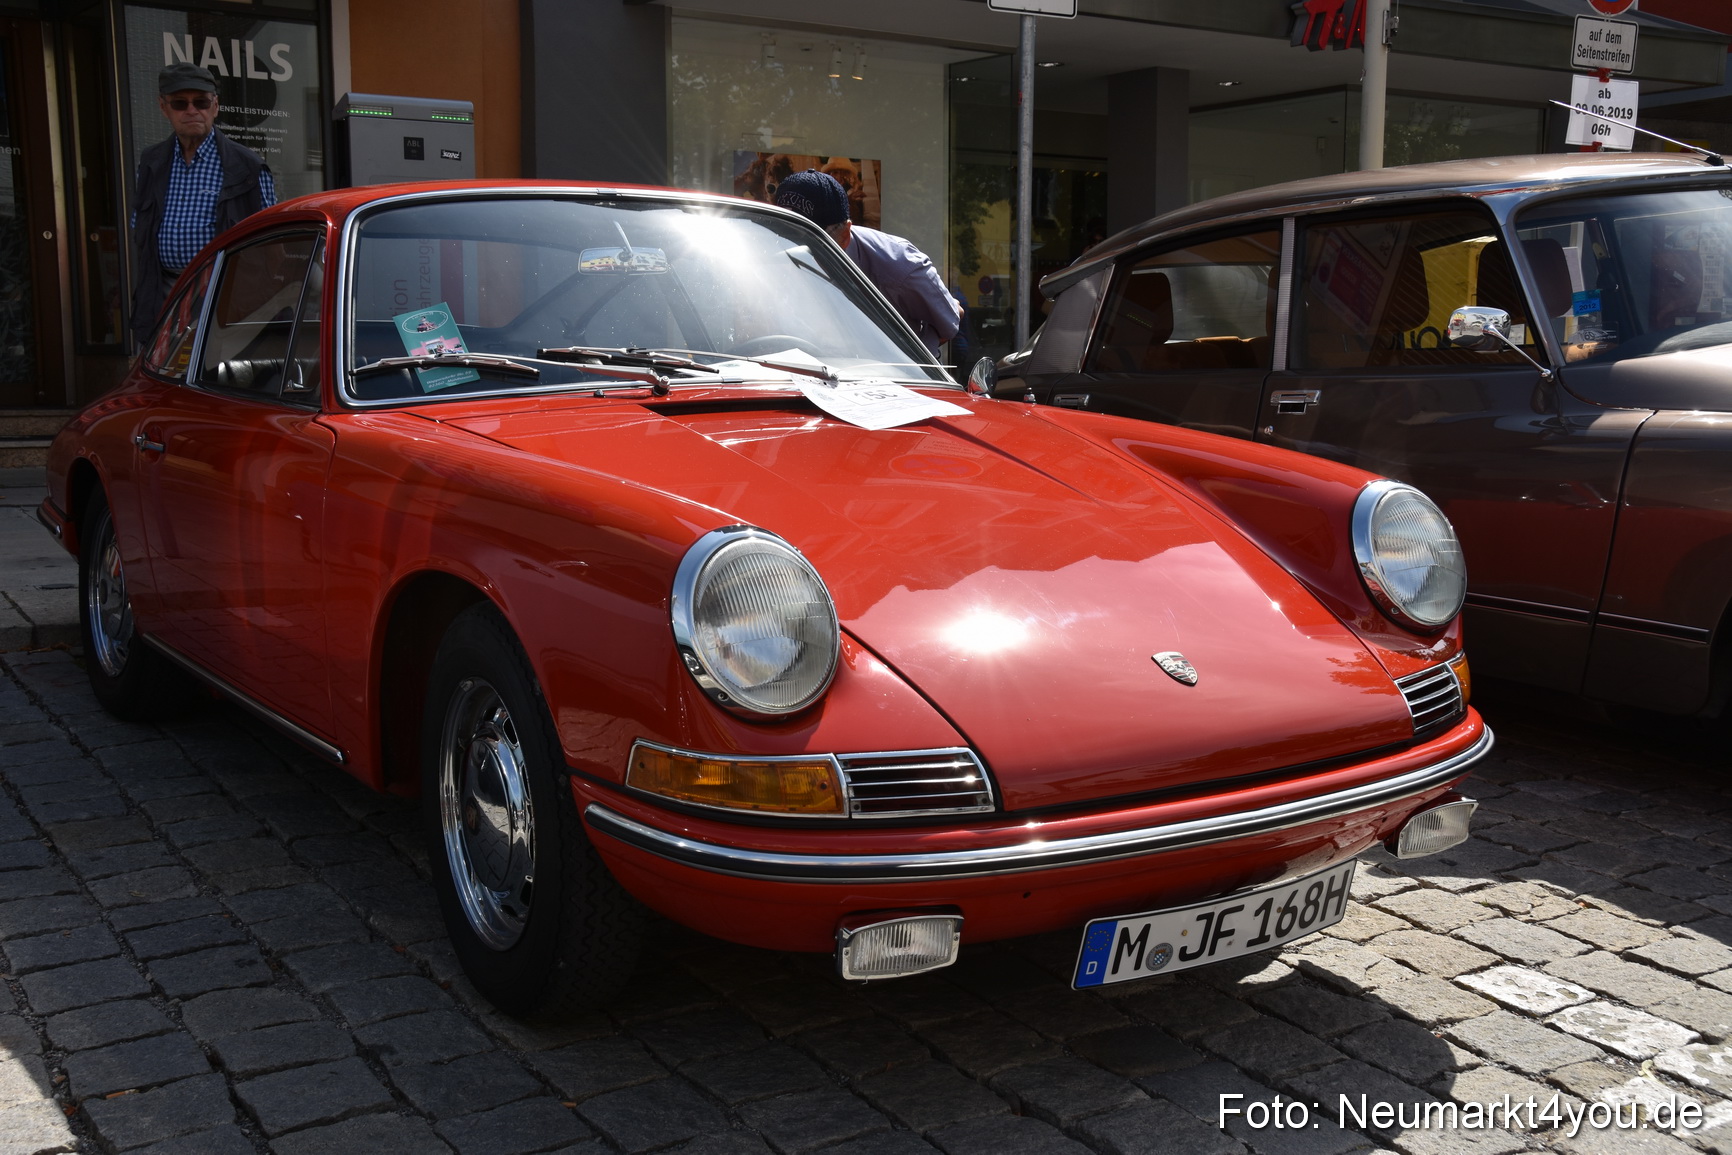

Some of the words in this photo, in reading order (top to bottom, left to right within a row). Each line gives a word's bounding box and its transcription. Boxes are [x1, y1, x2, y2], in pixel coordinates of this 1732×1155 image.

[1589, 28, 1602, 43] auf
[1605, 29, 1622, 44] dem
[162, 31, 293, 82] NAILS
[1576, 43, 1630, 64] Seitenstreifen
[1597, 87, 1612, 99] ab
[219, 104, 291, 118] ENSTLEISTUNGEN:
[1575, 103, 1633, 120] 0906.2019
[1591, 123, 1611, 136] 06h
[1578, 302, 1597, 311] 2012
[1111, 923, 1152, 975] M
[1178, 904, 1245, 962] JF
[1246, 869, 1350, 948] 168H
[1085, 961, 1098, 975] D
